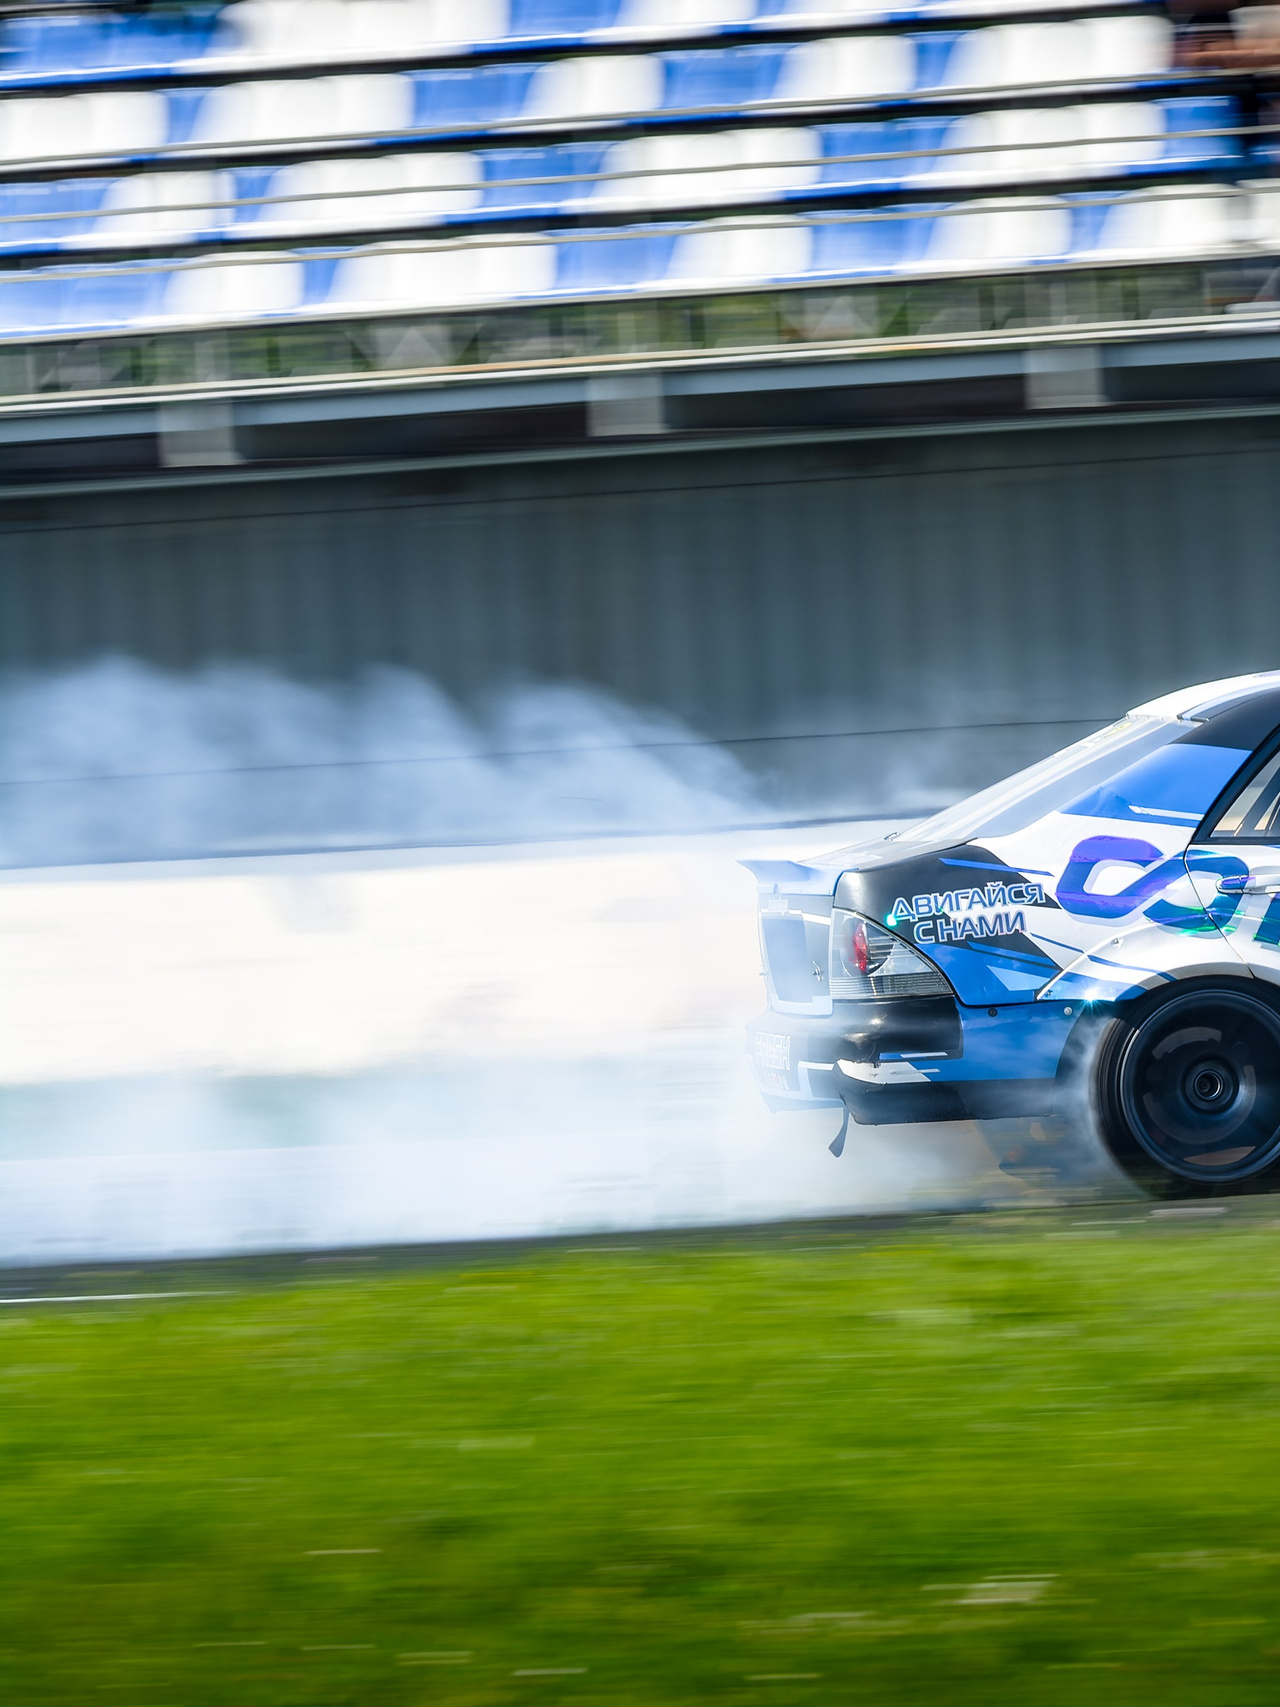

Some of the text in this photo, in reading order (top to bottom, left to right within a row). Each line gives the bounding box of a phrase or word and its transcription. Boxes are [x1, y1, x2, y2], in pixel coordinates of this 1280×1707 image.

[891, 881, 1045, 922] ДВИГАЙСЯ
[914, 910, 1027, 944] С НАМИ
